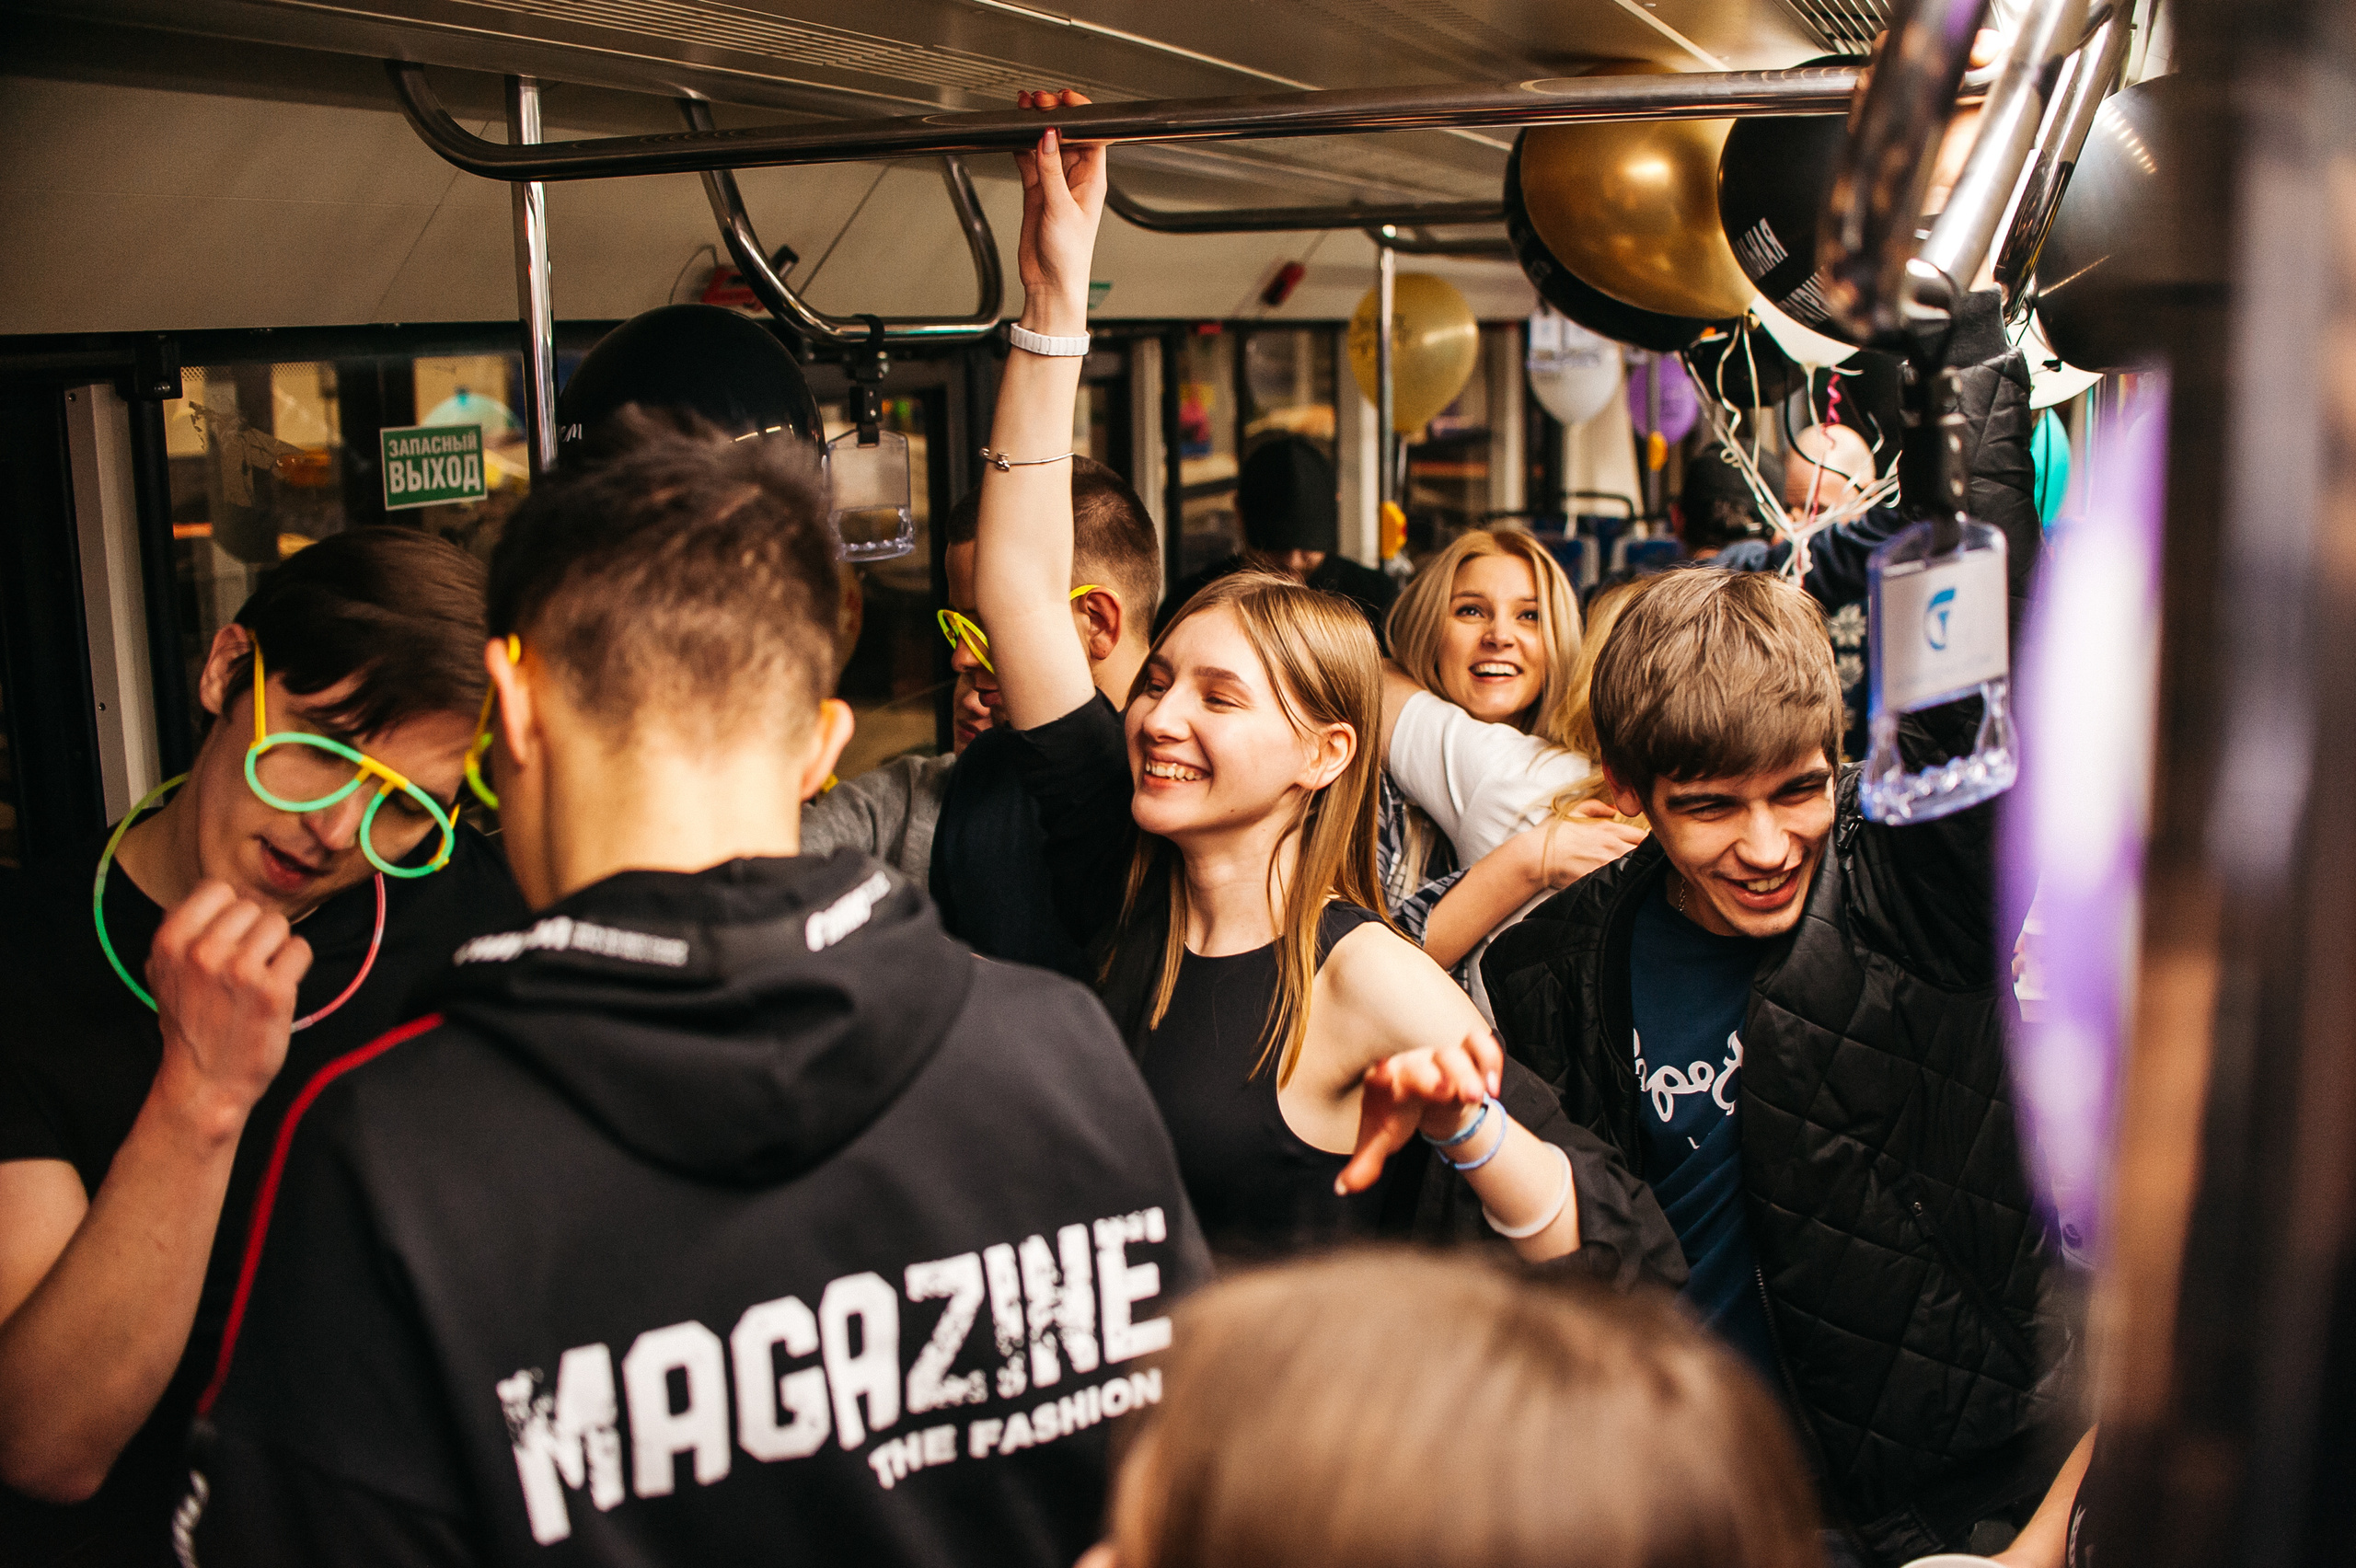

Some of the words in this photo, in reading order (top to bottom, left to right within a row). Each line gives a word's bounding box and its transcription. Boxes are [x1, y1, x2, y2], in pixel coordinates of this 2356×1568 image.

[388, 432, 477, 457] ЗАПАСНЫЙ
[388, 454, 481, 494] ВЫХОД
[497, 1206, 1173, 1546] MAGAZINE
[868, 1424, 958, 1490] THE
[968, 1367, 1163, 1458] FASHION
